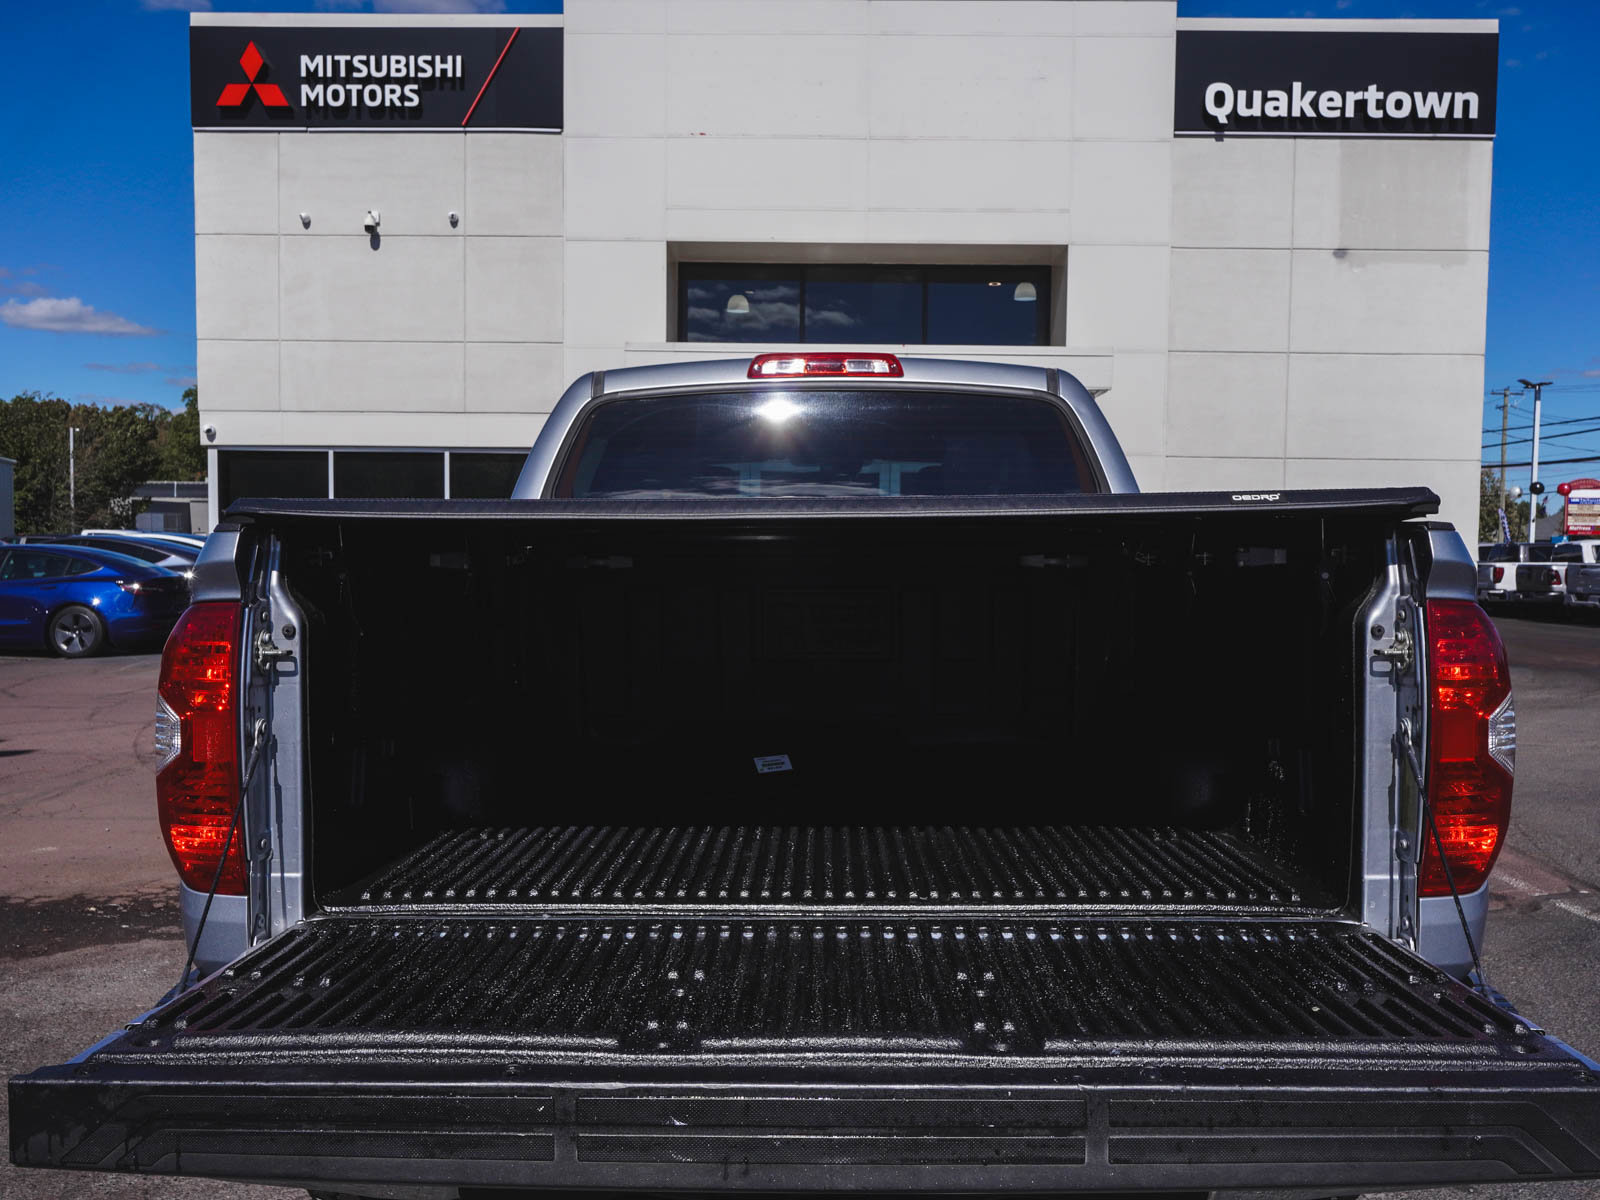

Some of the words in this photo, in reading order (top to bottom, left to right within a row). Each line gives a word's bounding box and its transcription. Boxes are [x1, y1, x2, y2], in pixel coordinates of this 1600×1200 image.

[300, 55, 463, 78] MITSUBISHI
[300, 84, 420, 107] MOTORS
[1204, 81, 1479, 124] Quakertown
